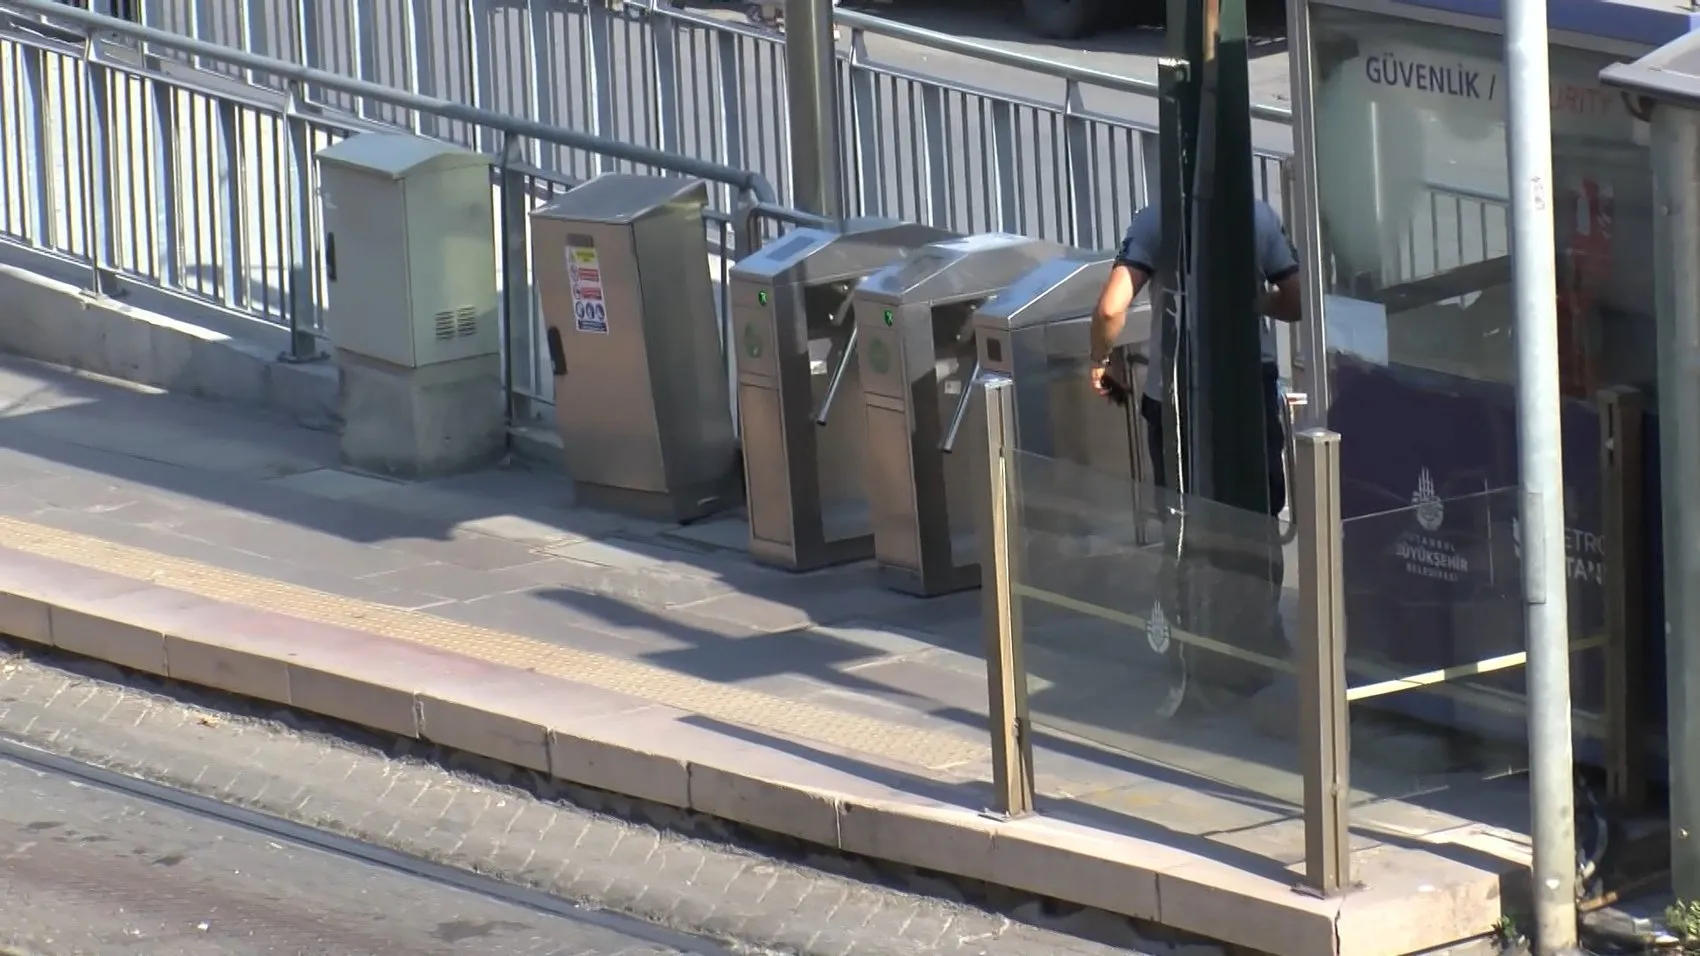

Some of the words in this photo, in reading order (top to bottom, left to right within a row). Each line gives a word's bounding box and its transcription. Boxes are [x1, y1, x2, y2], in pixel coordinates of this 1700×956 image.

[1365, 52, 1480, 99] GÜVENLİK
[1488, 74, 1496, 100] /
[1550, 83, 1611, 116] URITY
